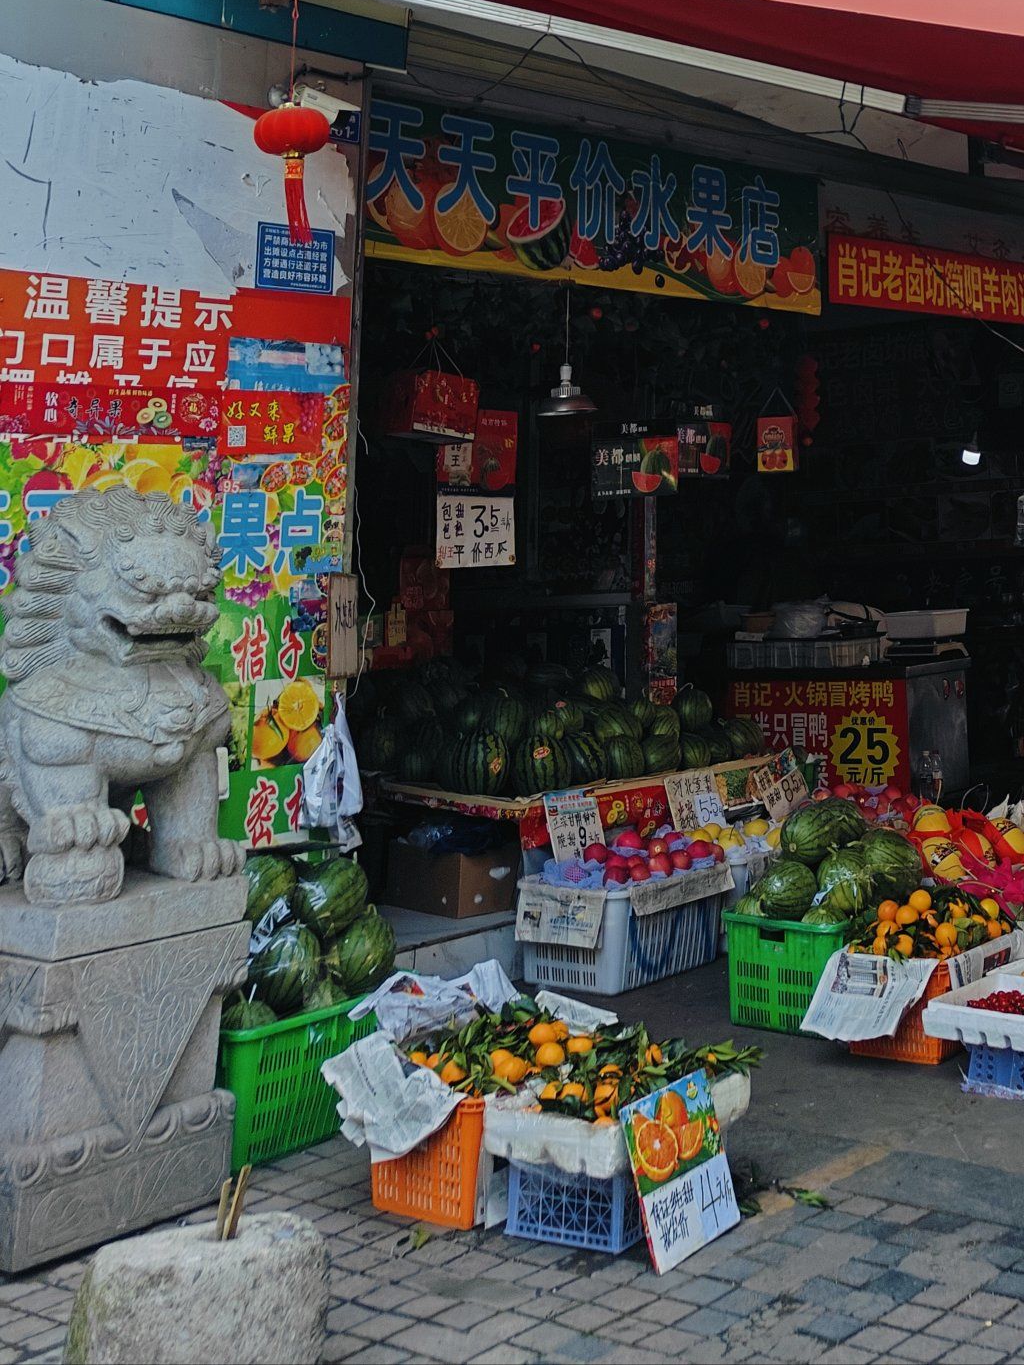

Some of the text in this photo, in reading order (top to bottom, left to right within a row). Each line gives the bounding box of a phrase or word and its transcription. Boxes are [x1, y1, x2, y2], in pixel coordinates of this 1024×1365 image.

[366, 98, 781, 266] 天天平价水果店
[24, 274, 234, 331] 温馨提示
[0, 329, 216, 373] 门口属于应
[64, 397, 123, 421] 奇异果
[226, 400, 281, 421] 好又来
[453, 540, 508, 565] 平价西瓜
[734, 680, 895, 708] 肖记·火锅冒烤鸭
[851, 716, 875, 726] 优惠价
[839, 726, 890, 765] 25
[846, 766, 885, 785] 元/斤
